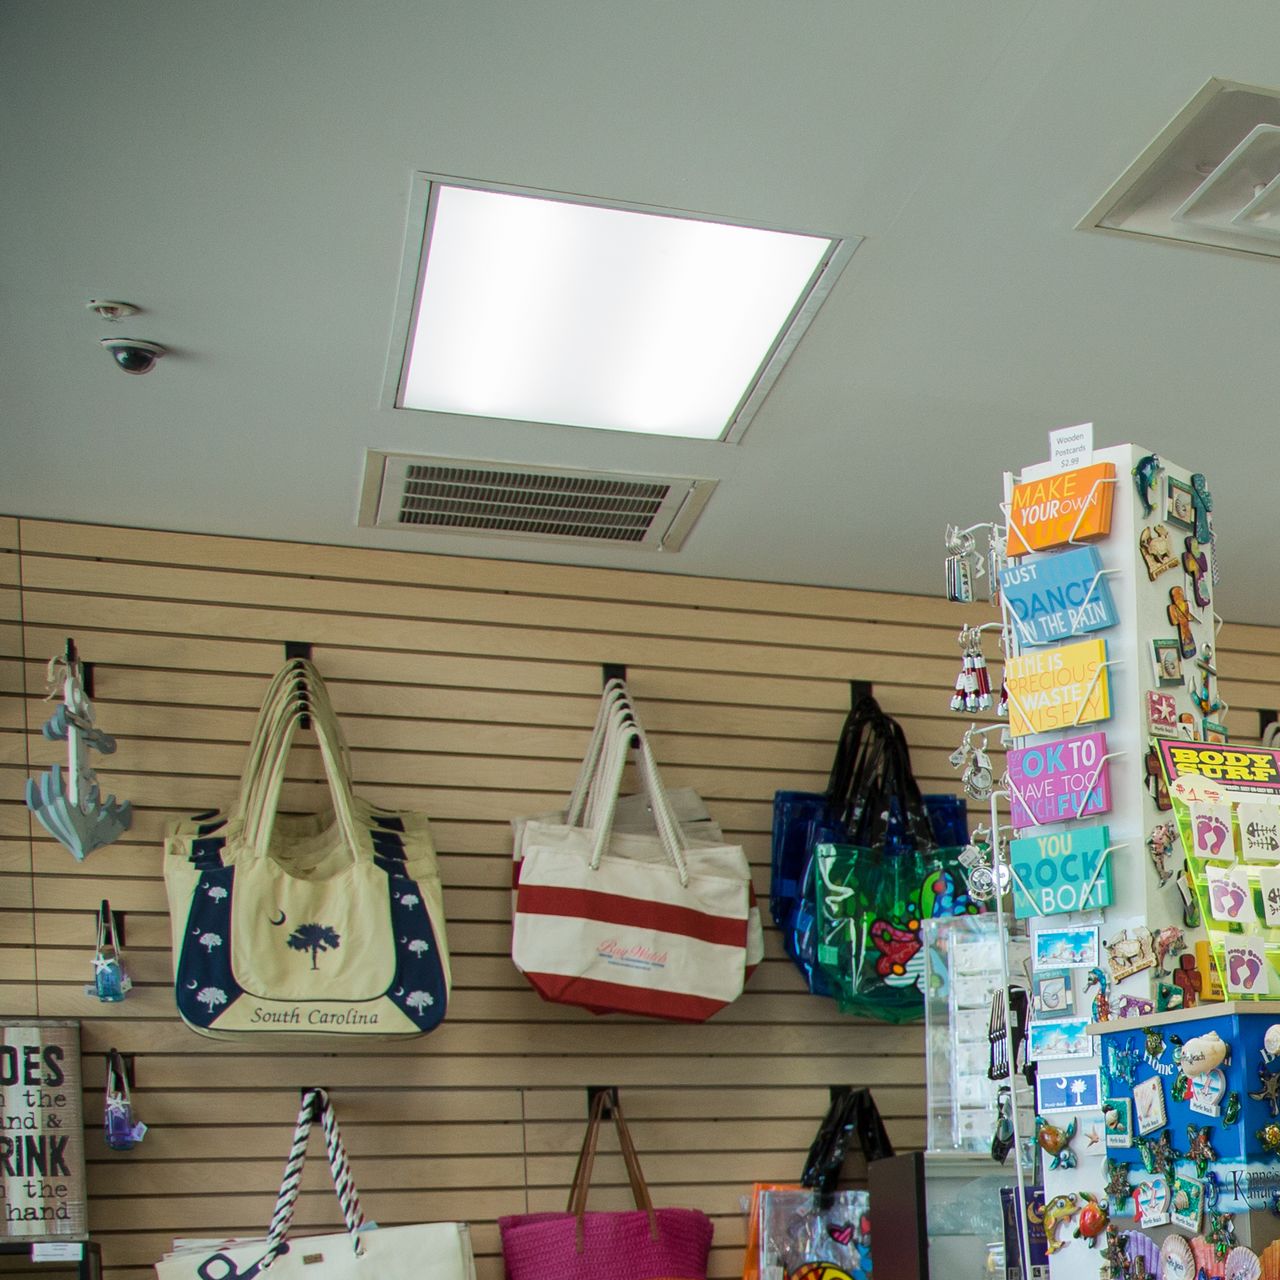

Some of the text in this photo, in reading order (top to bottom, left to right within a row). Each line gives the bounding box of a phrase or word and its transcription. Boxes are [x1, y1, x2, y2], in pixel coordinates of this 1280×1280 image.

[1055, 444, 1086, 457] Postcards
[1056, 433, 1085, 445] Wooden
[1061, 457, 1080, 468] $2.99
[1014, 473, 1078, 500] MAKE
[1021, 492, 1098, 526] YOUR OWN
[1003, 564, 1037, 588] JUST
[1009, 577, 1100, 621] DANCE
[1038, 612, 1067, 637] THE
[1067, 601, 1107, 630] RAIN
[1007, 653, 1063, 679] TIME IS
[1008, 660, 1101, 694] PRECIOUS
[1021, 683, 1082, 711] WASTE
[1011, 699, 1101, 734] WISELY
[1022, 744, 1067, 777] OK
[1068, 739, 1096, 769] TO
[1169, 748, 1273, 768] BODY
[1175, 763, 1277, 782] SURF
[1012, 771, 1098, 803] HAVE TOO
[1013, 787, 1104, 823] MUCH FUN
[1038, 833, 1072, 858] YOU
[1014, 849, 1104, 892] ROCK
[1041, 880, 1106, 913] BOAT
[597, 939, 628, 960] Bay
[629, 945, 668, 963] Watch
[251, 1007, 379, 1025] South Carolina
[23, 1090, 66, 1108] the
[46, 1114, 63, 1129] &
[23, 1181, 68, 1199] the
[6, 1203, 71, 1222] hand
